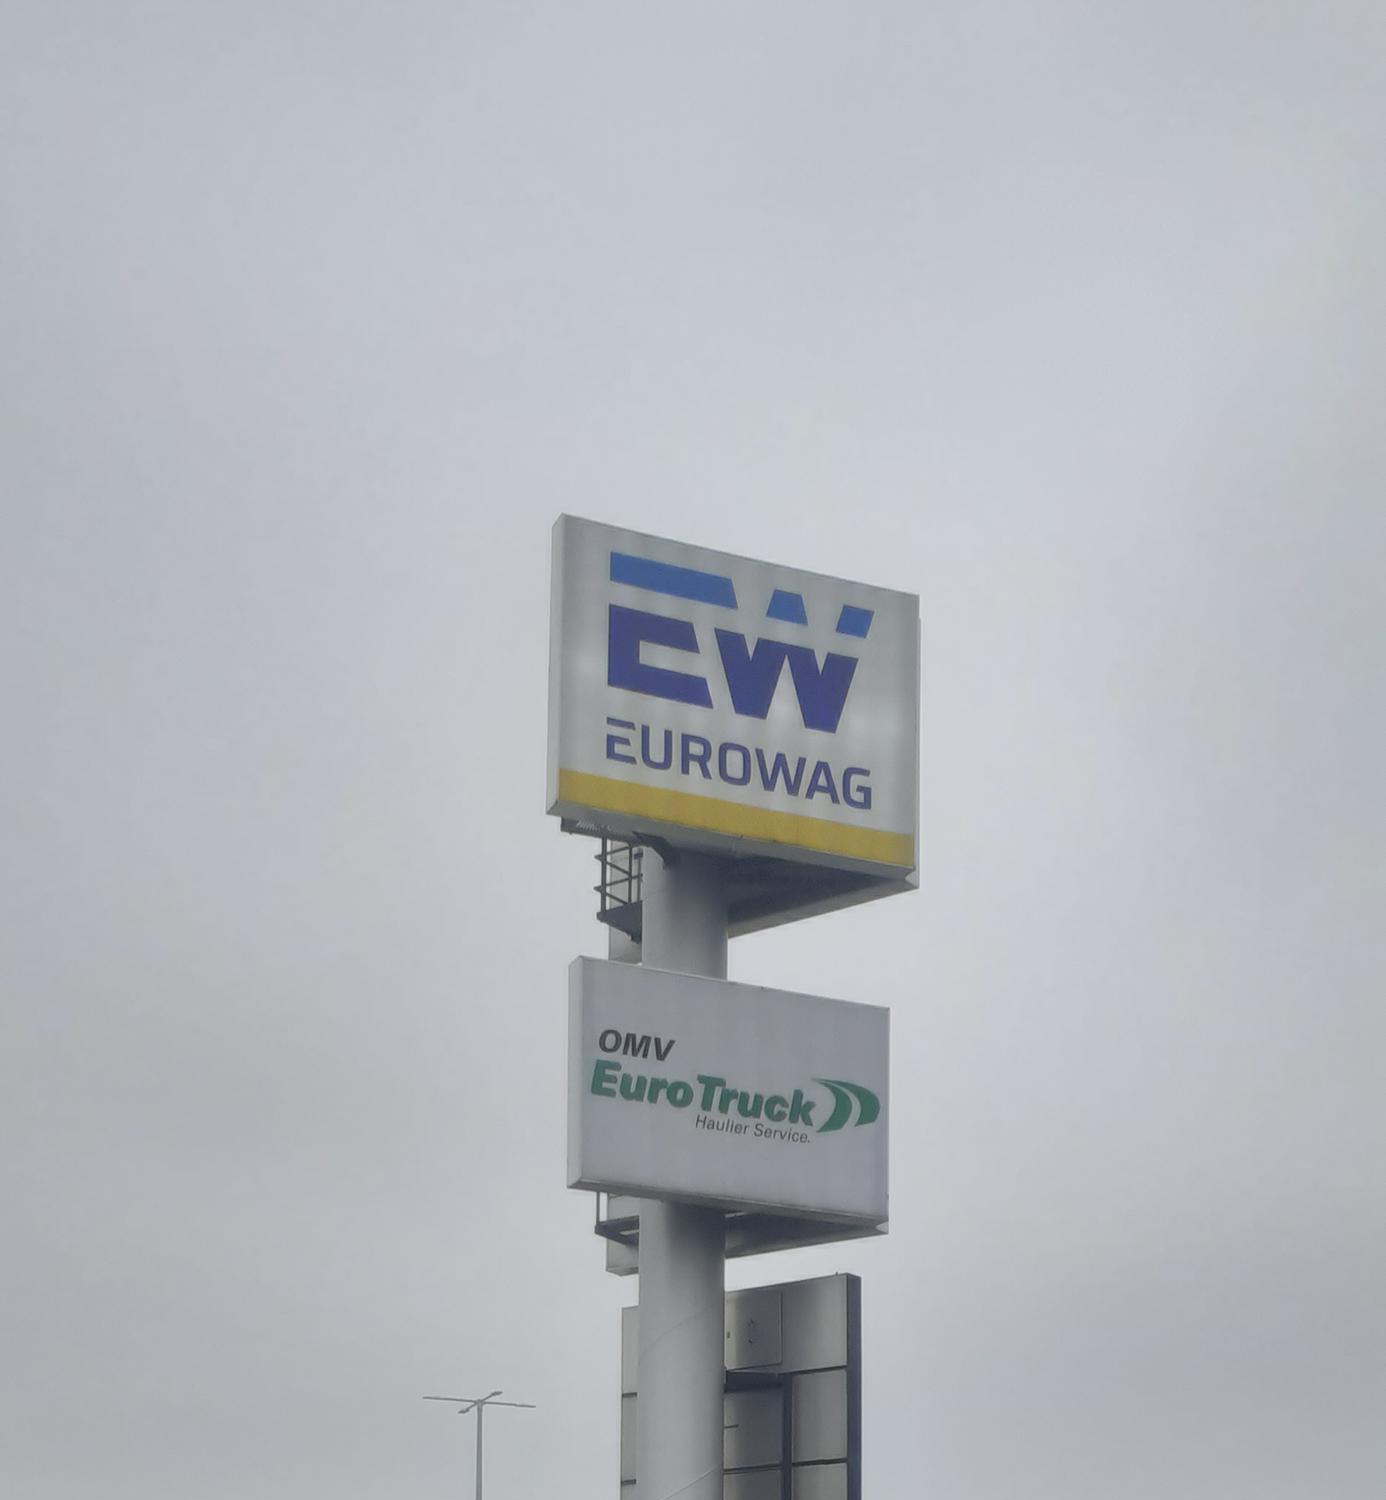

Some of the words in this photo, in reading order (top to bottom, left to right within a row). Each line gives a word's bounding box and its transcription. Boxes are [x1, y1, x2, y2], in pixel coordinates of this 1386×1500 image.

[606, 717, 872, 811] EUROWAG
[598, 1029, 675, 1062] OMV
[695, 1114, 748, 1135] Haulier
[753, 1122, 811, 1144] Service.
